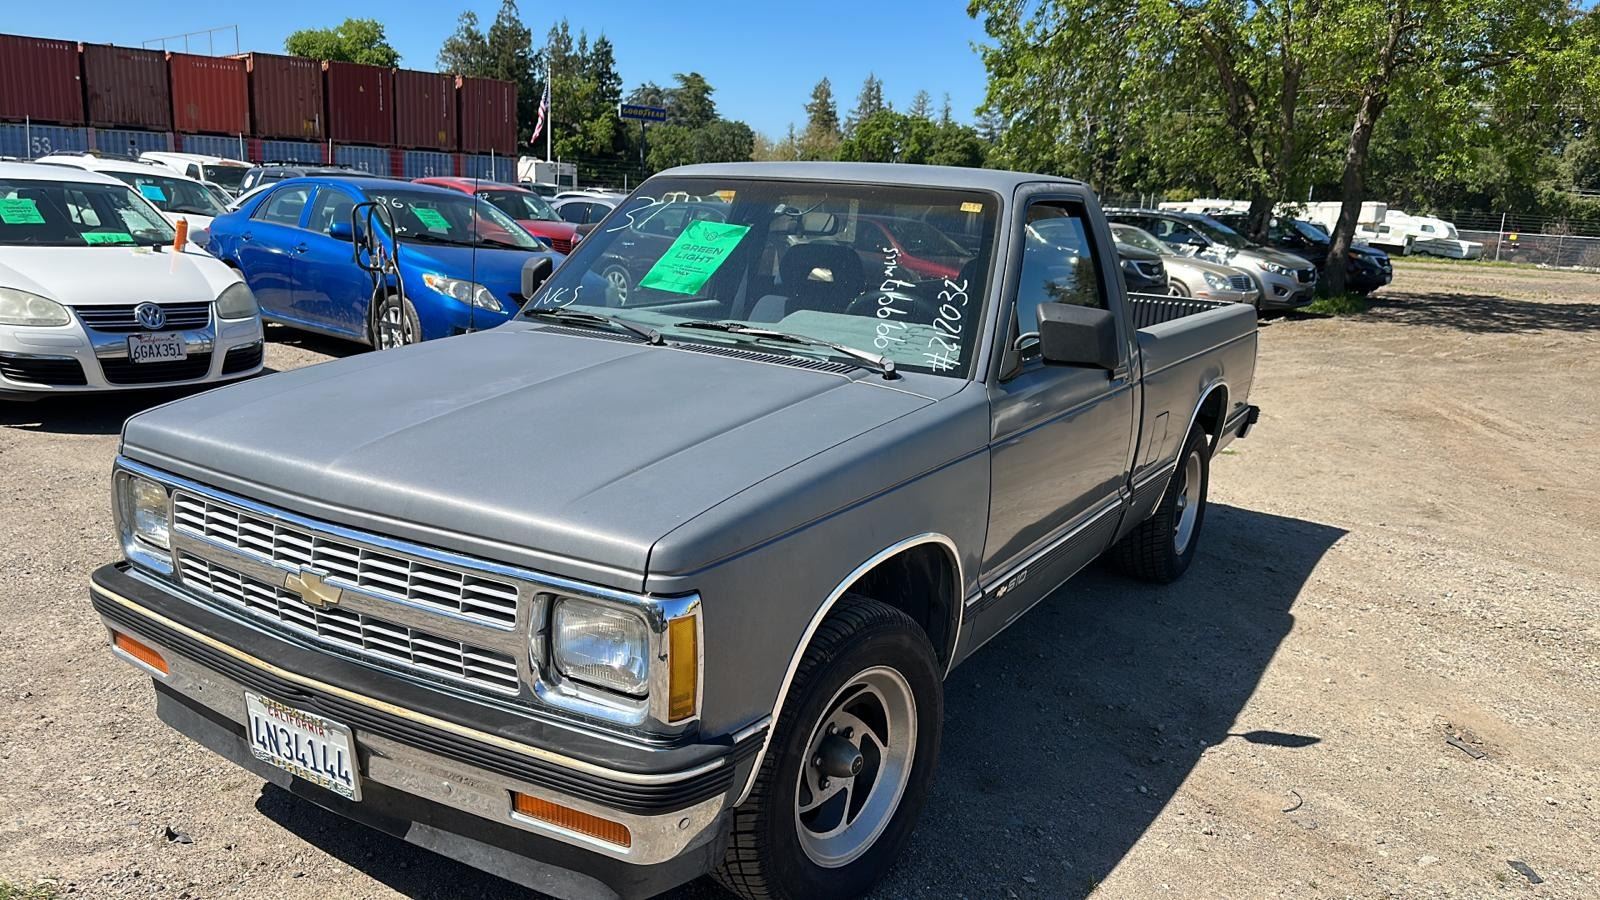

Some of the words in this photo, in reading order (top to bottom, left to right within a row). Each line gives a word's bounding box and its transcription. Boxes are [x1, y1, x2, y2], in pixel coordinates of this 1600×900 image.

[31, 136, 51, 153] 53
[673, 251, 715, 264] LIGHT
[680, 243, 725, 256] GREEN
[922, 279, 969, 373] #212032
[133, 343, 183, 359] 6GAX351
[267, 706, 325, 737] CALIFORNIA
[254, 716, 351, 787] 4N34144
